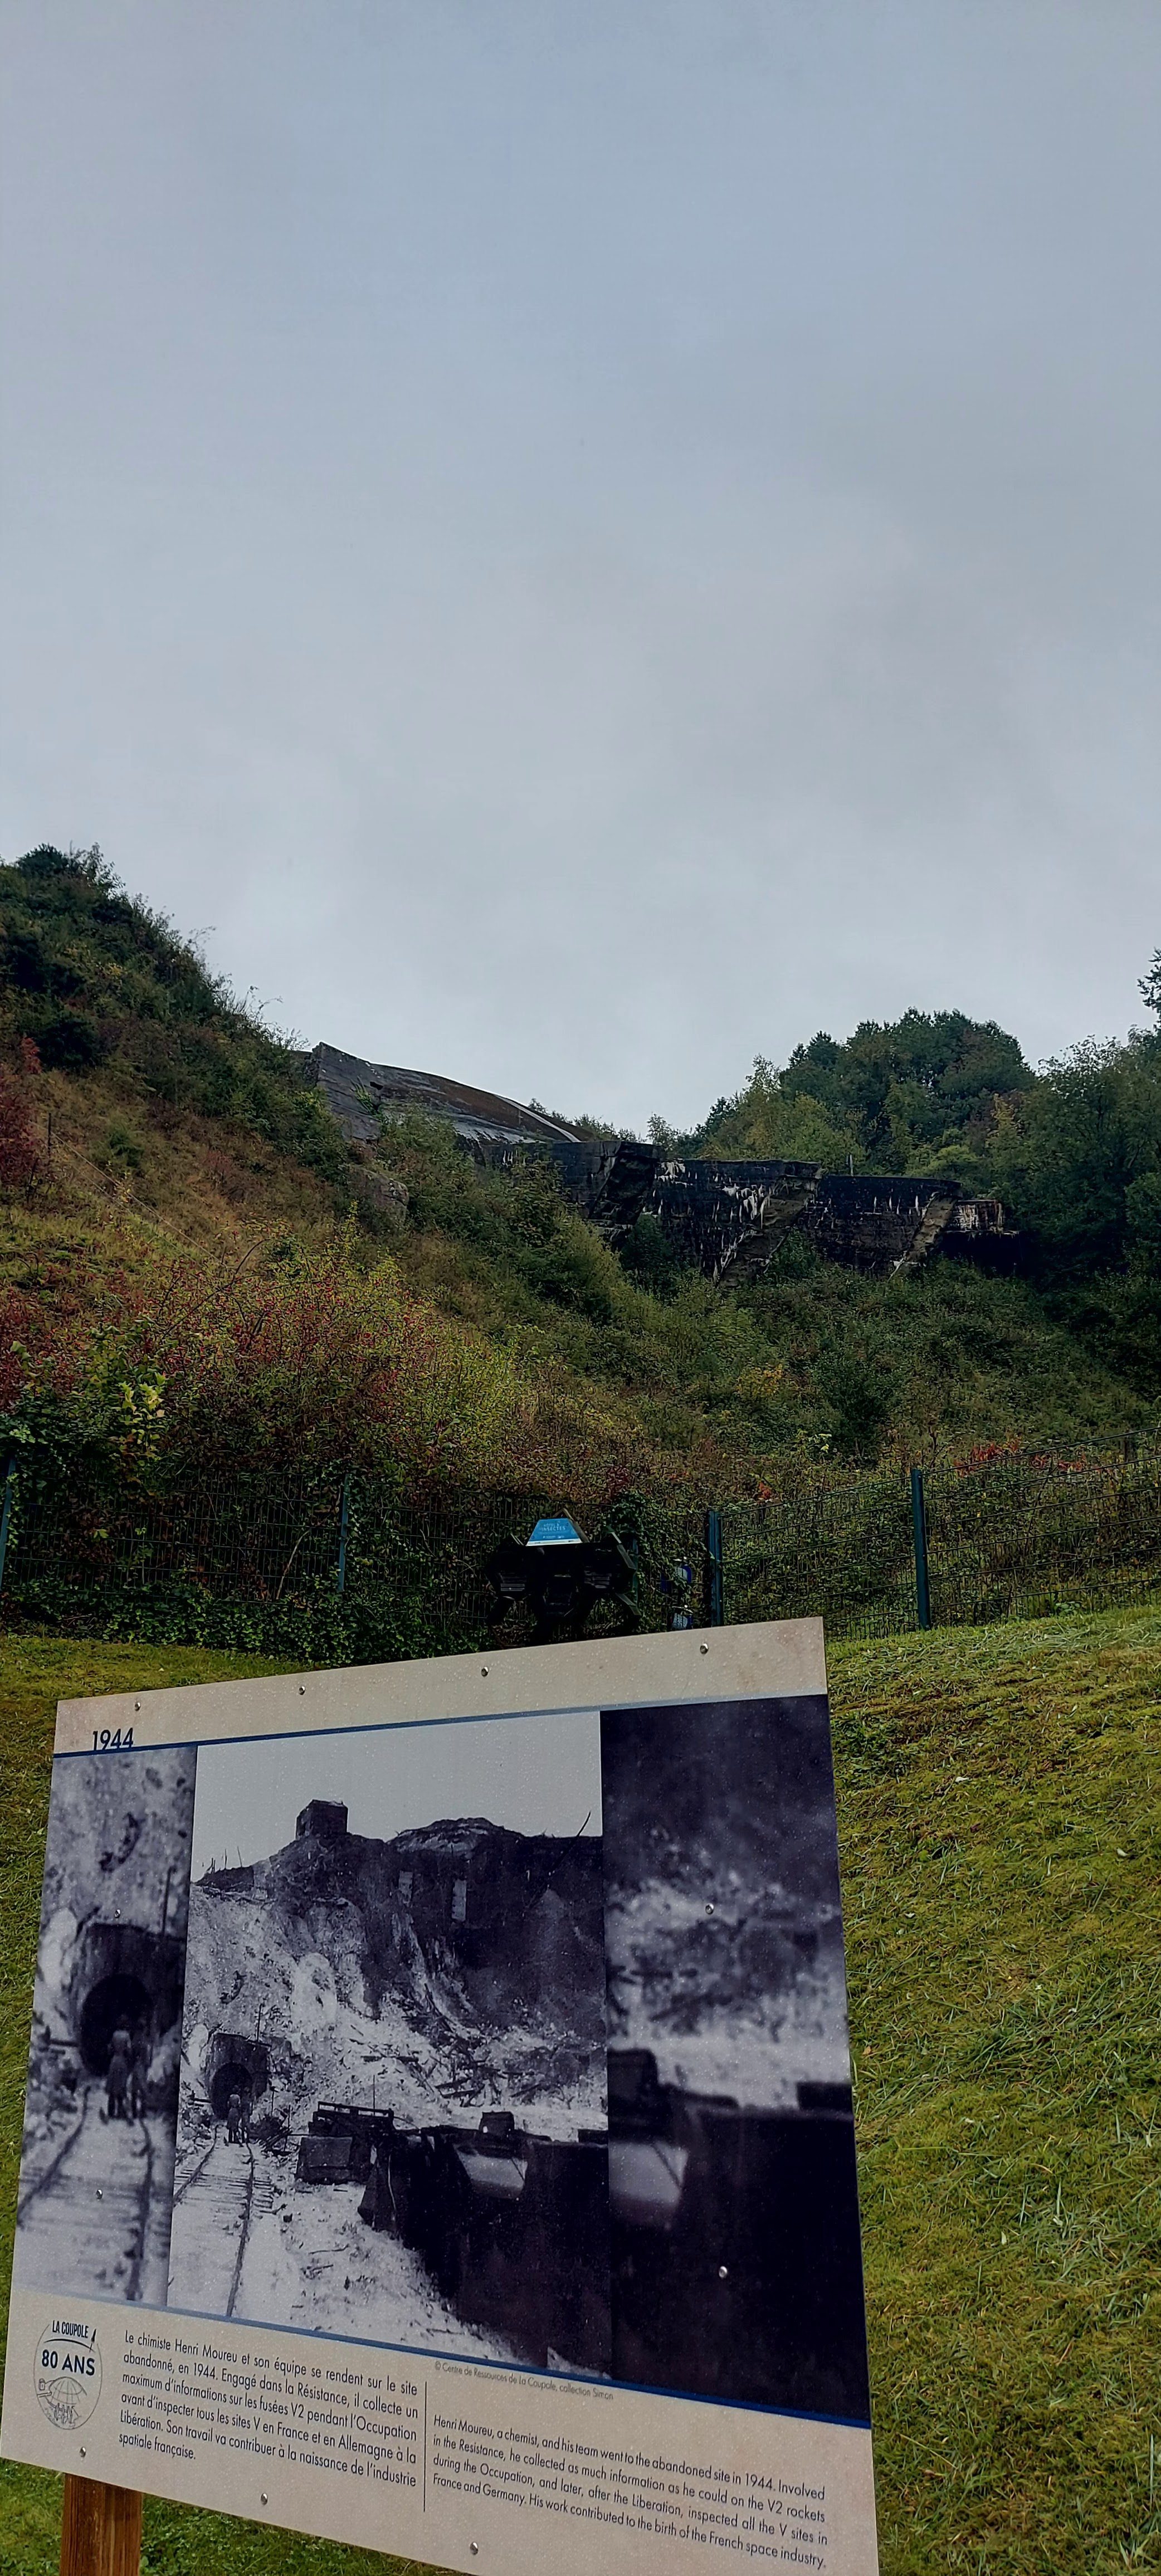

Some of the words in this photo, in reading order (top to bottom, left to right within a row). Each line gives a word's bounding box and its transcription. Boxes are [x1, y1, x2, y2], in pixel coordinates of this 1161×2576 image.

[92, 1728, 133, 1751] 1944
[42, 2349, 58, 2369] 80
[62, 2353, 95, 2376] ANS
[52, 2320, 60, 2333] LA
[62, 2321, 89, 2339] COUPOLE
[125, 2330, 134, 2344] Le
[138, 2331, 171, 2350] chimiste
[175, 2338, 198, 2355] Henri
[202, 2344, 237, 2363] Moureu
[241, 2353, 250, 2365] et
[253, 2357, 270, 2369] son
[274, 2357, 306, 2378] équipe
[311, 2368, 321, 2378] se
[326, 2367, 363, 2386] rendent
[368, 2378, 383, 2389] sur
[387, 2375, 396, 2392] le
[401, 2380, 417, 2396] site
[122, 2374, 162, 2390] maximum
[164, 2377, 227, 2403] d’informations
[229, 2395, 243, 2406] sur
[245, 2392, 257, 2409] les
[260, 2395, 288, 2416] fusées
[291, 2402, 304, 2418] V2
[307, 2409, 348, 2427] pendant
[350, 2413, 417, 2441] l’Occupation
[123, 2349, 175, 2374] abandonné,
[178, 2364, 189, 2375] en
[194, 2362, 218, 2380] 1944.
[222, 2368, 256, 2390] Engagé
[260, 2374, 282, 2393] dans
[285, 2378, 294, 2395] la
[297, 2382, 350, 2408] Résistance,
[354, 2392, 359, 2407] il
[363, 2395, 402, 2416] collecte
[406, 2407, 418, 2419] un
[442, 2362, 463, 2374] Centre
[464, 2366, 472, 2376] de
[474, 2367, 507, 2382] Ressources
[508, 2373, 518, 2384] de
[528, 2377, 558, 2392] Coupole,
[559, 2383, 591, 2396] collection
[119, 2433, 152, 2450] spatiale
[154, 2436, 196, 2460] française.
[120, 2409, 163, 2432] Libération.
[166, 2419, 183, 2436] Son
[186, 2425, 213, 2442] travail
[215, 2434, 226, 2445] va
[229, 2437, 276, 2456] contribuer
[279, 2443, 285, 2458] à
[287, 2444, 296, 2461] la
[300, 2451, 348, 2472] naissance
[350, 2458, 364, 2476] de
[367, 2461, 416, 2487] l’industrie
[121, 2394, 145, 2407] avant
[147, 2394, 194, 2417] d’inspecter
[197, 2407, 214, 2422] tous
[217, 2408, 229, 2425] les
[232, 2413, 251, 2429] sites
[253, 2416, 261, 2431] V
[262, 2423, 274, 2434] en
[277, 2421, 309, 2441] France
[311, 2432, 321, 2444] et
[323, 2436, 335, 2447] en
[338, 2434, 393, 2461] Allemagne
[396, 2446, 403, 2461] à
[407, 2446, 416, 2464] la
[433, 2414, 457, 2429] Henri
[458, 2419, 494, 2440] Moureu,
[497, 2430, 503, 2439] a
[504, 2427, 539, 2448] chemist,
[542, 2436, 560, 2450] and
[562, 2437, 574, 2453] his
[575, 2443, 598, 2457] team
[600, 2450, 623, 2462] went
[625, 2452, 634, 2464] to
[636, 2452, 650, 2467] the
[652, 2456, 712, 2479] abandoned
[714, 2468, 730, 2482] site
[733, 2471, 741, 2485] in
[746, 2473, 775, 2491] 1944.
[778, 2479, 825, 2500] Involved
[433, 2434, 441, 2446] in
[443, 2434, 456, 2450] the
[459, 2438, 506, 2462] Resistance,
[510, 2447, 520, 2462] he
[524, 2452, 565, 2471] collected
[568, 2464, 579, 2474] as
[582, 2465, 607, 2480] much
[609, 2468, 665, 2491] information
[668, 2484, 680, 2495] as
[683, 2481, 695, 2497] he
[699, 2488, 728, 2504] could
[731, 2496, 744, 2507] on
[748, 2495, 764, 2511] the
[768, 2499, 783, 2515] V2
[787, 2504, 825, 2523] rockets
[433, 2453, 461, 2473] during
[464, 2458, 476, 2473] the
[480, 2463, 535, 2488] Occupation,
[539, 2477, 558, 2490] and
[560, 2478, 583, 2497] later,
[588, 2485, 611, 2501] after
[614, 2489, 628, 2505] the
[632, 2494, 683, 2519] Liberation,
[688, 2506, 738, 2528] inspected
[742, 2516, 755, 2530] all
[759, 2519, 775, 2535] the
[779, 2523, 787, 2536] V
[791, 2527, 813, 2543] sites
[818, 2531, 827, 2545] in
[433, 2472, 462, 2490] France
[464, 2481, 481, 2494] and
[482, 2483, 526, 2507] Germany.
[529, 2492, 543, 2508] His
[545, 2499, 568, 2513] work
[570, 2506, 625, 2525] contributed
[626, 2515, 635, 2528] to
[637, 2515, 652, 2531] the
[655, 2518, 676, 2536] birth
[679, 2525, 690, 2539] of
[691, 2526, 707, 2543] the
[709, 2530, 743, 2550] French
[746, 2543, 778, 2558] space
[780, 2546, 825, 2570] industry.
